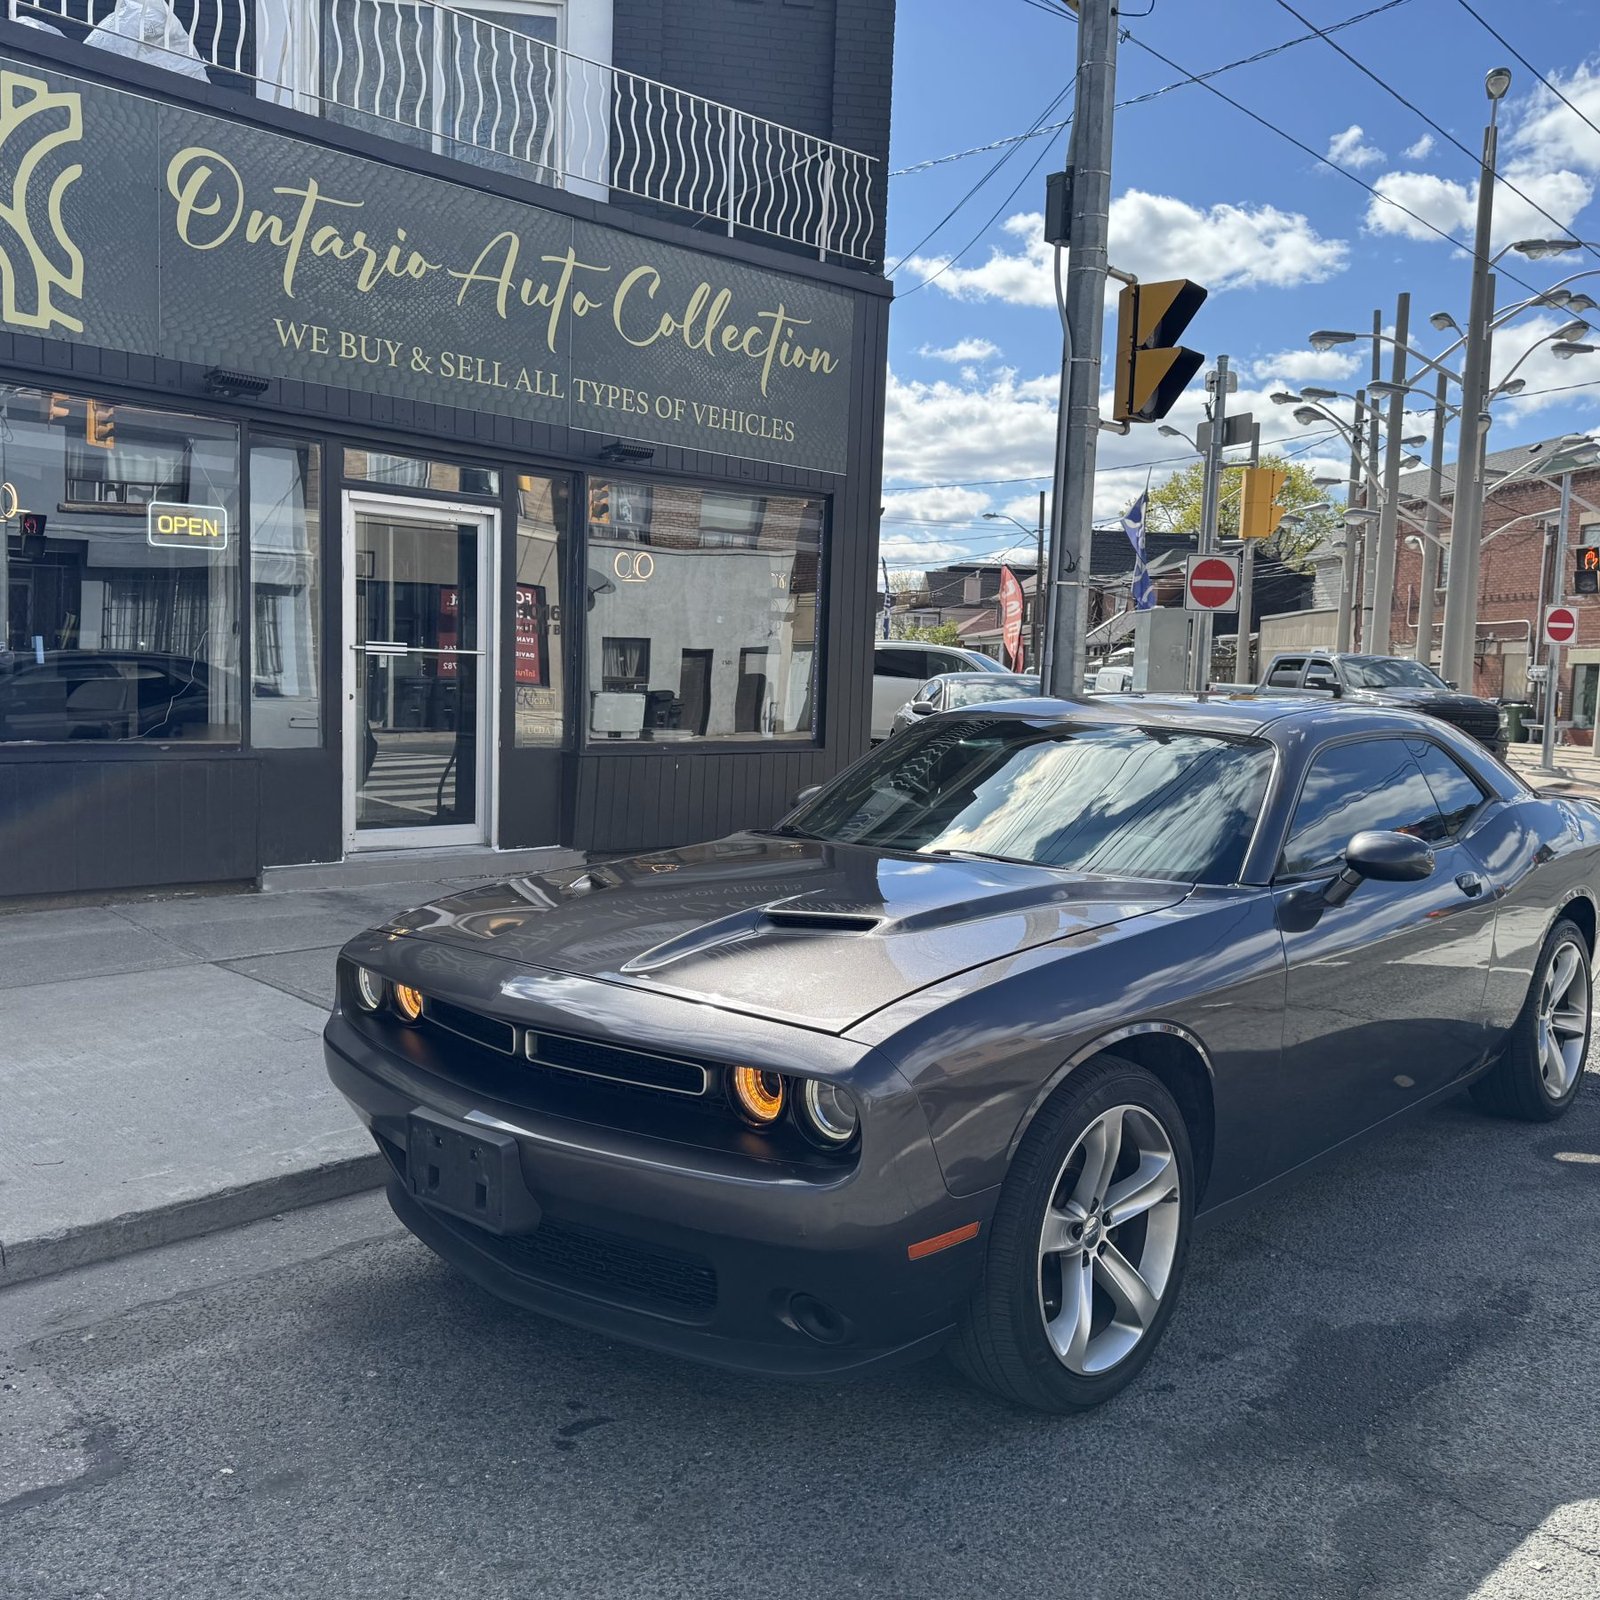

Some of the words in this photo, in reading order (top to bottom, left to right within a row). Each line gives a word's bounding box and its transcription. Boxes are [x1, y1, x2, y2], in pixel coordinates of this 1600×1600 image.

[167, 147, 442, 298] Ontario
[447, 231, 611, 353] Auto
[613, 265, 839, 397] Collection
[273, 318, 330, 354] WE
[338, 330, 403, 367] BUY
[410, 346, 433, 374] &
[440, 351, 508, 388] SELL
[514, 367, 565, 398] ALL
[572, 378, 649, 415] TYPES
[655, 395, 687, 421] OF
[691, 401, 795, 442] VEHICLES
[158, 515, 218, 537] OPEN
